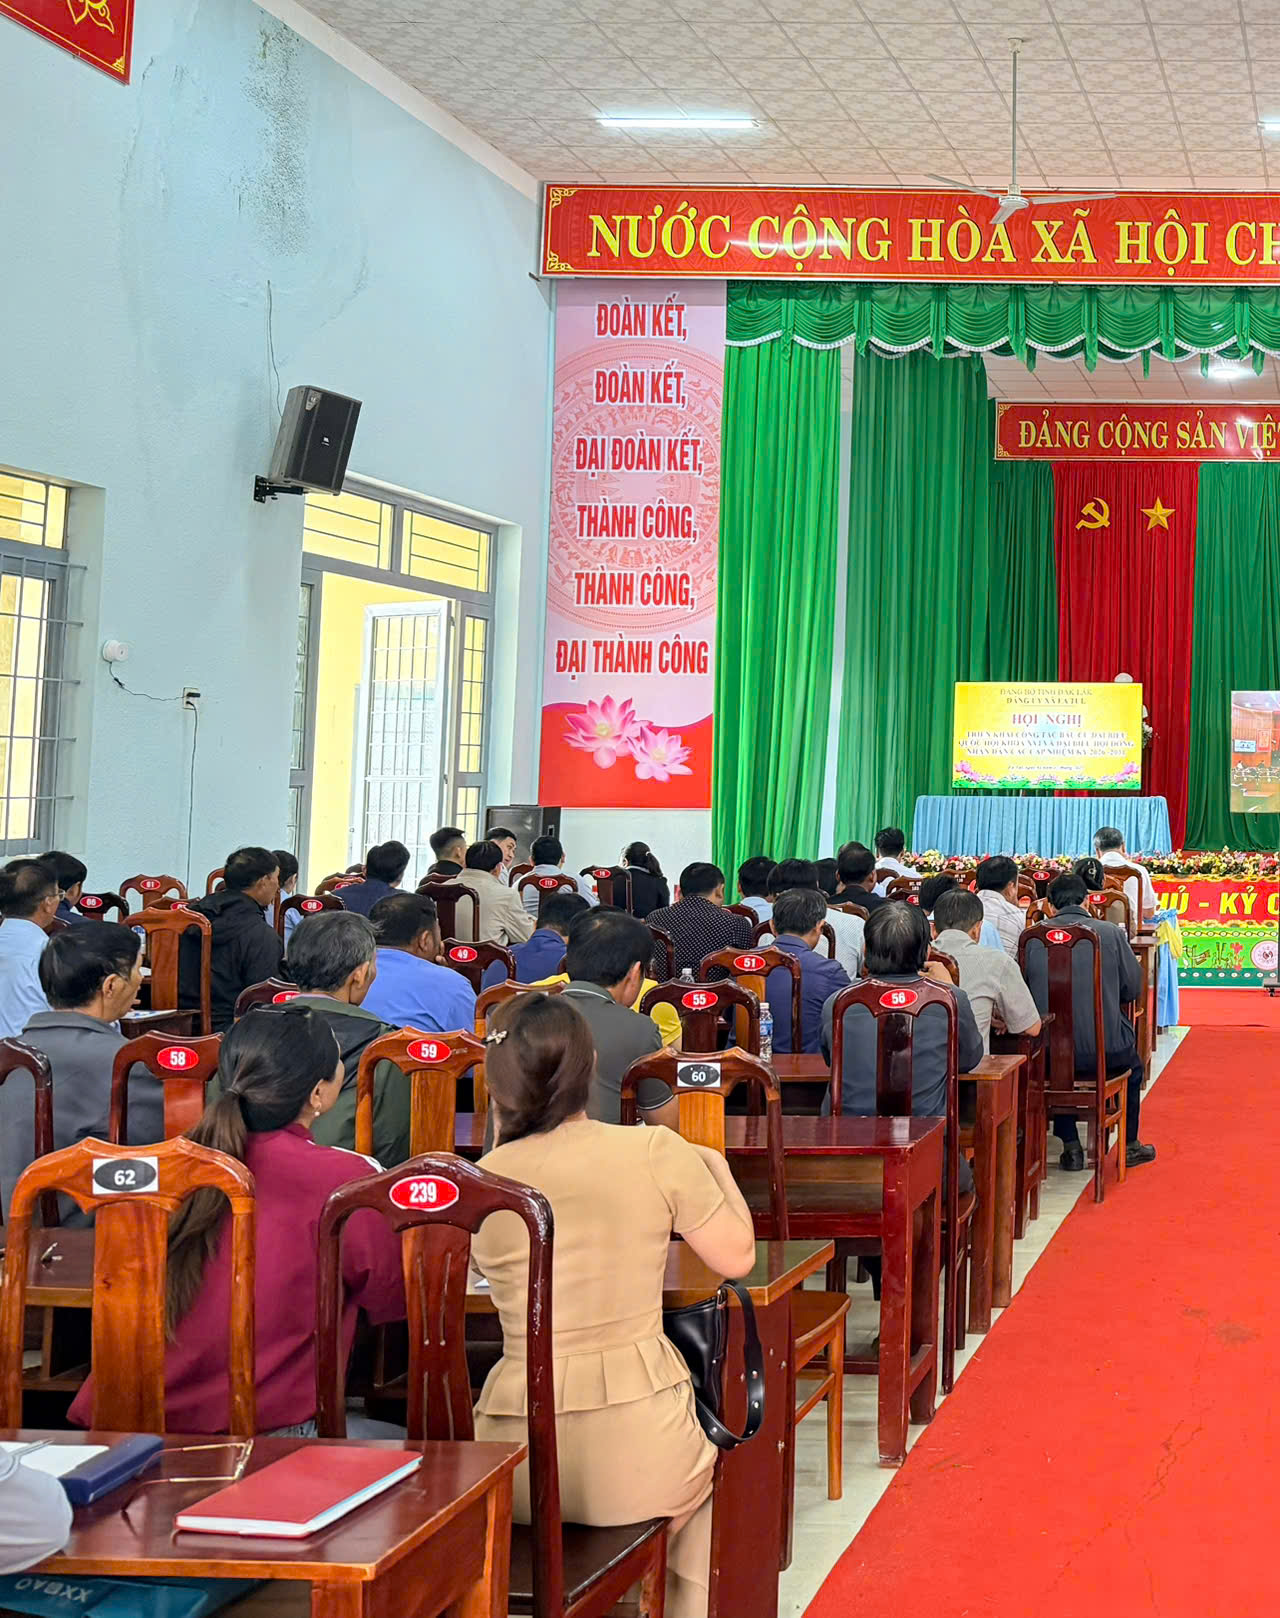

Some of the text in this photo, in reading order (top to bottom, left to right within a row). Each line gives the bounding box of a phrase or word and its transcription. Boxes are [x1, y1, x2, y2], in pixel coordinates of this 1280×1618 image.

[588, 206, 732, 259] NƯỚC
[748, 204, 899, 271] CỘNG
[907, 205, 1016, 262] HÒA
[1031, 208, 1097, 263] XÃ
[1114, 207, 1209, 274] HỘI
[597, 294, 687, 340] ĐOÀN KẾT,
[595, 361, 686, 408] ĐOÀN KẾT,
[1019, 410, 1090, 448] ĐẢNG
[1099, 413, 1168, 456] CỘNG
[1177, 410, 1227, 449] SẢN
[576, 428, 702, 477] ĐẠI ĐOÀN KẾT,
[577, 498, 697, 542] THÀNH CÔNG,
[575, 566, 695, 610] THÀNH CÔNG,
[556, 634, 709, 680] ĐẠI THÀNH CÔNG
[1219, 885, 1258, 915] KỶ
[457, 949, 469, 959] 49
[743, 957, 757, 968] 51
[692, 993, 707, 1005] 55
[891, 993, 906, 1005] 56
[170, 1051, 186, 1065] 58
[421, 1043, 438, 1058] 59
[691, 1071, 706, 1083] 60
[113, 1168, 136, 1187] 62
[408, 1182, 437, 1204] 239
